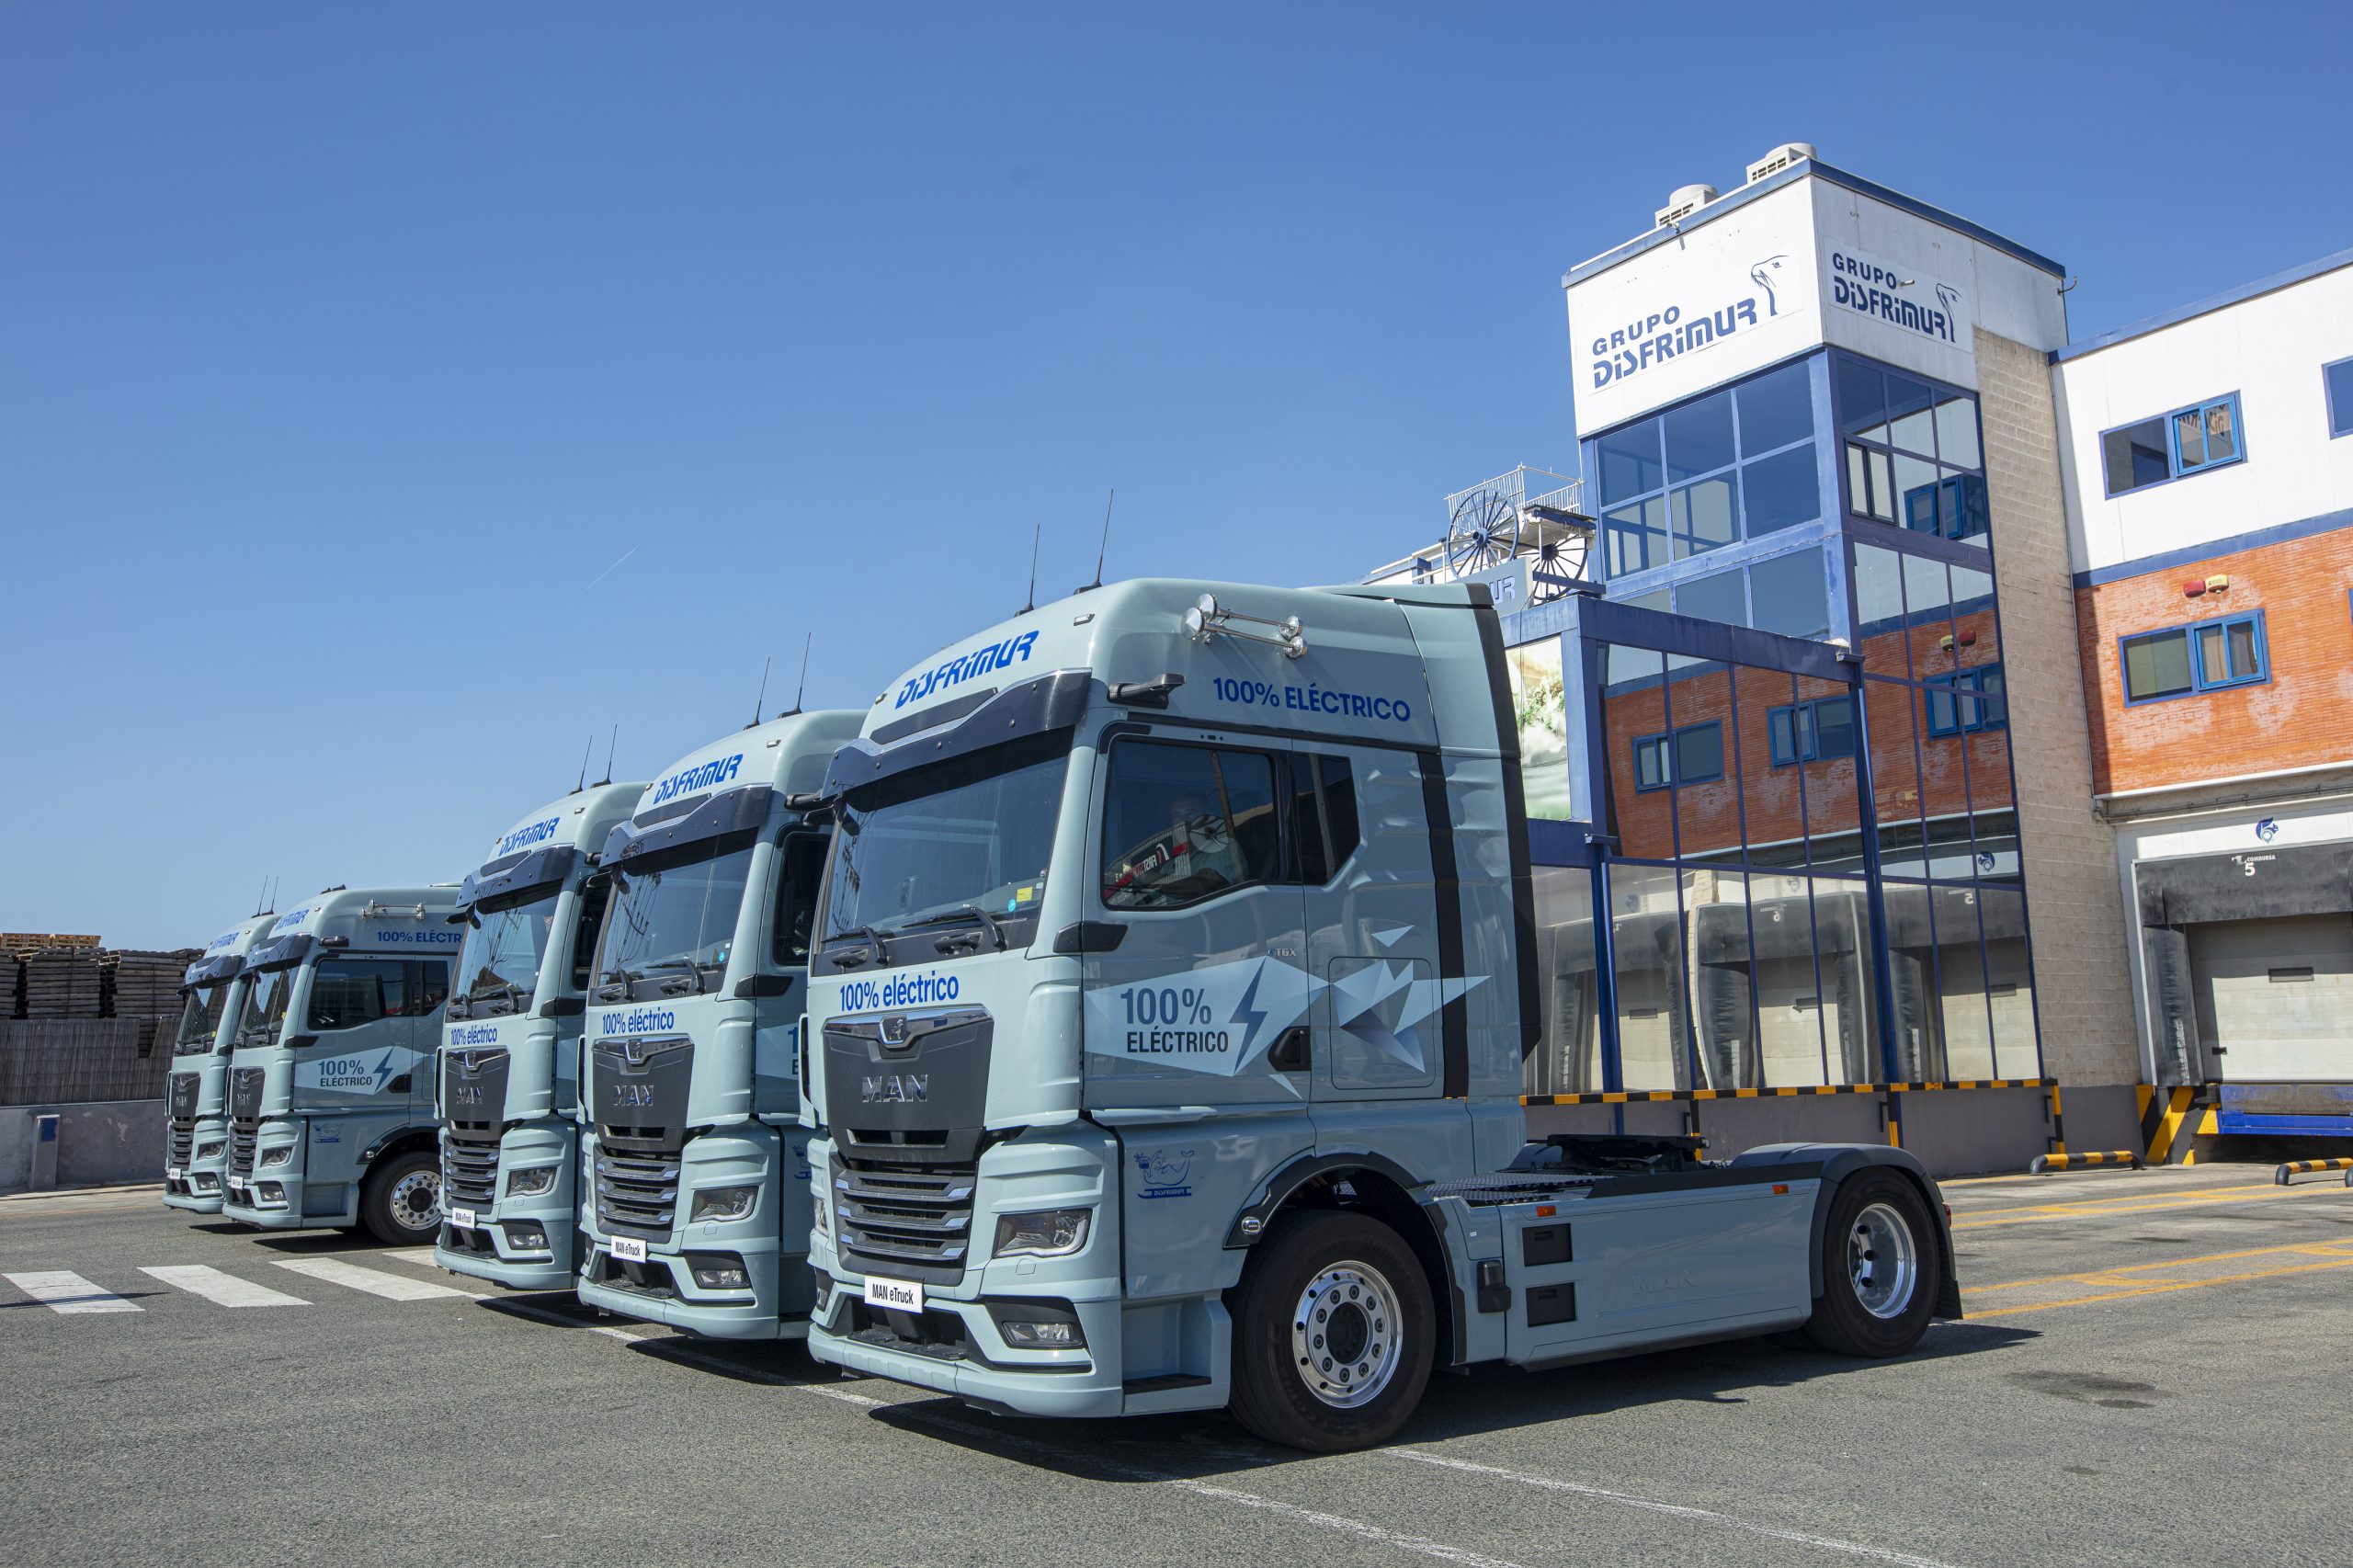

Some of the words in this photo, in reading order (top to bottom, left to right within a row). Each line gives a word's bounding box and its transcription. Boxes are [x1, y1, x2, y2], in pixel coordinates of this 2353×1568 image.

[1832, 252, 1897, 290] GRUPO
[1593, 305, 1681, 356] GRUPO
[1212, 676, 1280, 709] 100%
[1285, 682, 1412, 722] ELÉCTRICO
[2245, 862, 2256, 877] 5
[377, 931, 413, 942] 100%
[415, 929, 463, 943] ELÉCTR
[840, 981, 880, 1012] 100%
[882, 971, 960, 1006] eléctrico
[1120, 988, 1212, 1026] 100%
[602, 1012, 626, 1035] 100%
[628, 1007, 675, 1033] eléctrico
[450, 1029, 466, 1046] 100%
[467, 1024, 498, 1044] eléctrico
[1126, 1025, 1229, 1054] ELÉCTRICO
[318, 1060, 364, 1075] 100%
[320, 1074, 372, 1087] ELÉCTRICO
[861, 1074, 928, 1103] MAN
[456, 1086, 484, 1105] MAN
[613, 1085, 654, 1107] MAN
[615, 1241, 624, 1254] MAN
[625, 1243, 641, 1257] eTruck
[872, 1284, 888, 1301] MAN
[889, 1288, 914, 1305] eTruck
